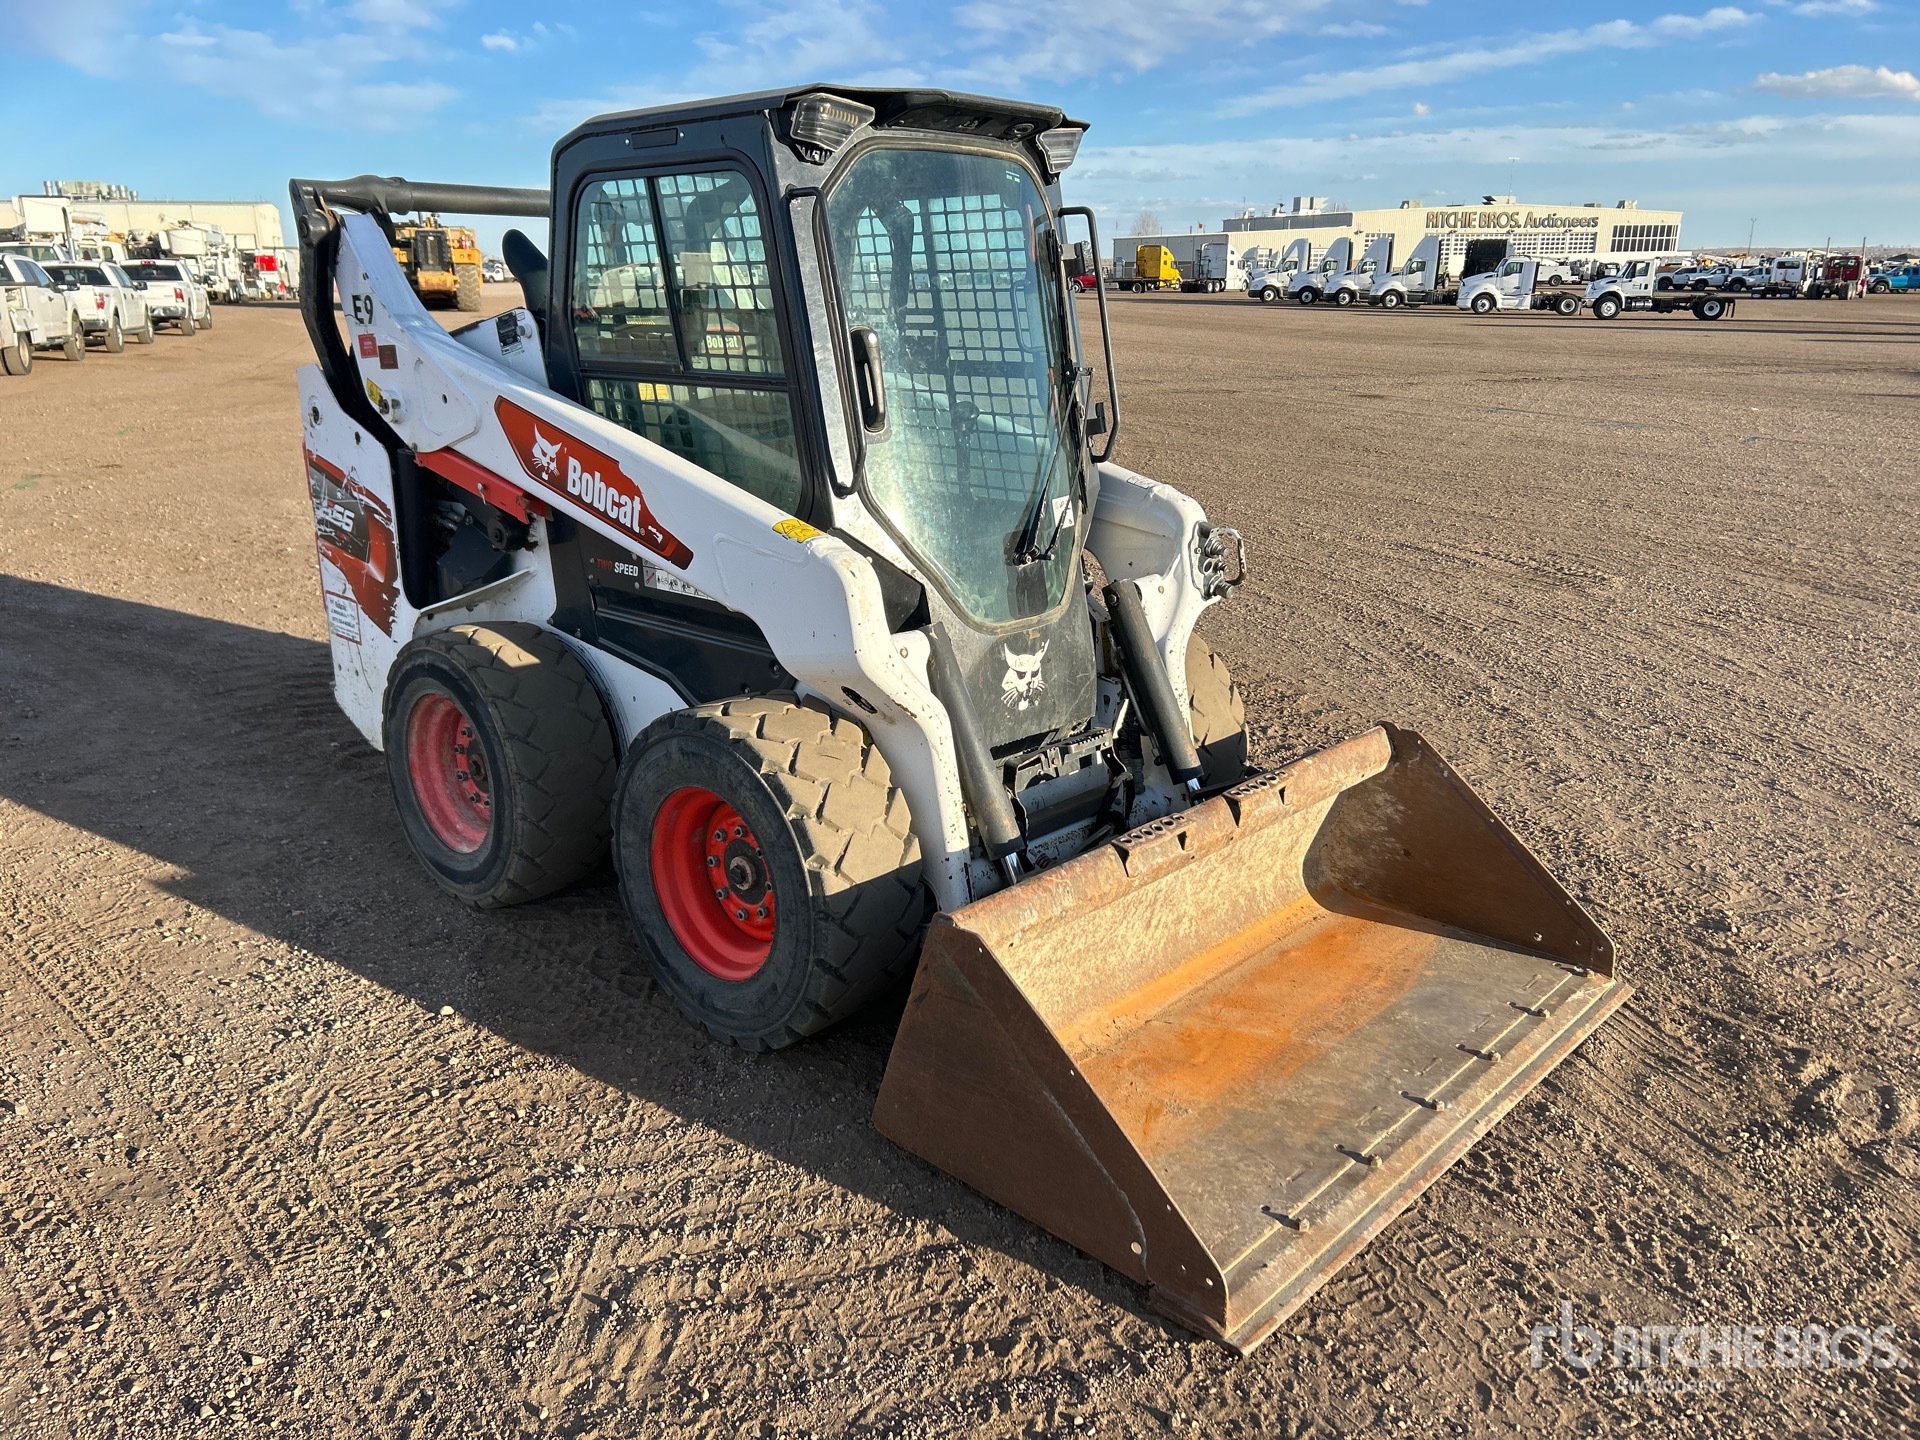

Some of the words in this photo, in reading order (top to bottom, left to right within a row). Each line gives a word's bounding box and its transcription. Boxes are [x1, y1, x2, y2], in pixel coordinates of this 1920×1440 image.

[1425, 211, 1477, 229] RITCHIE
[1478, 211, 1522, 229] BROS.
[1523, 211, 1599, 229] Auctioneers
[352, 294, 374, 325] E9
[567, 456, 641, 533] Bobcat
[596, 559, 613, 570] TWO
[614, 561, 639, 577] SPEED
